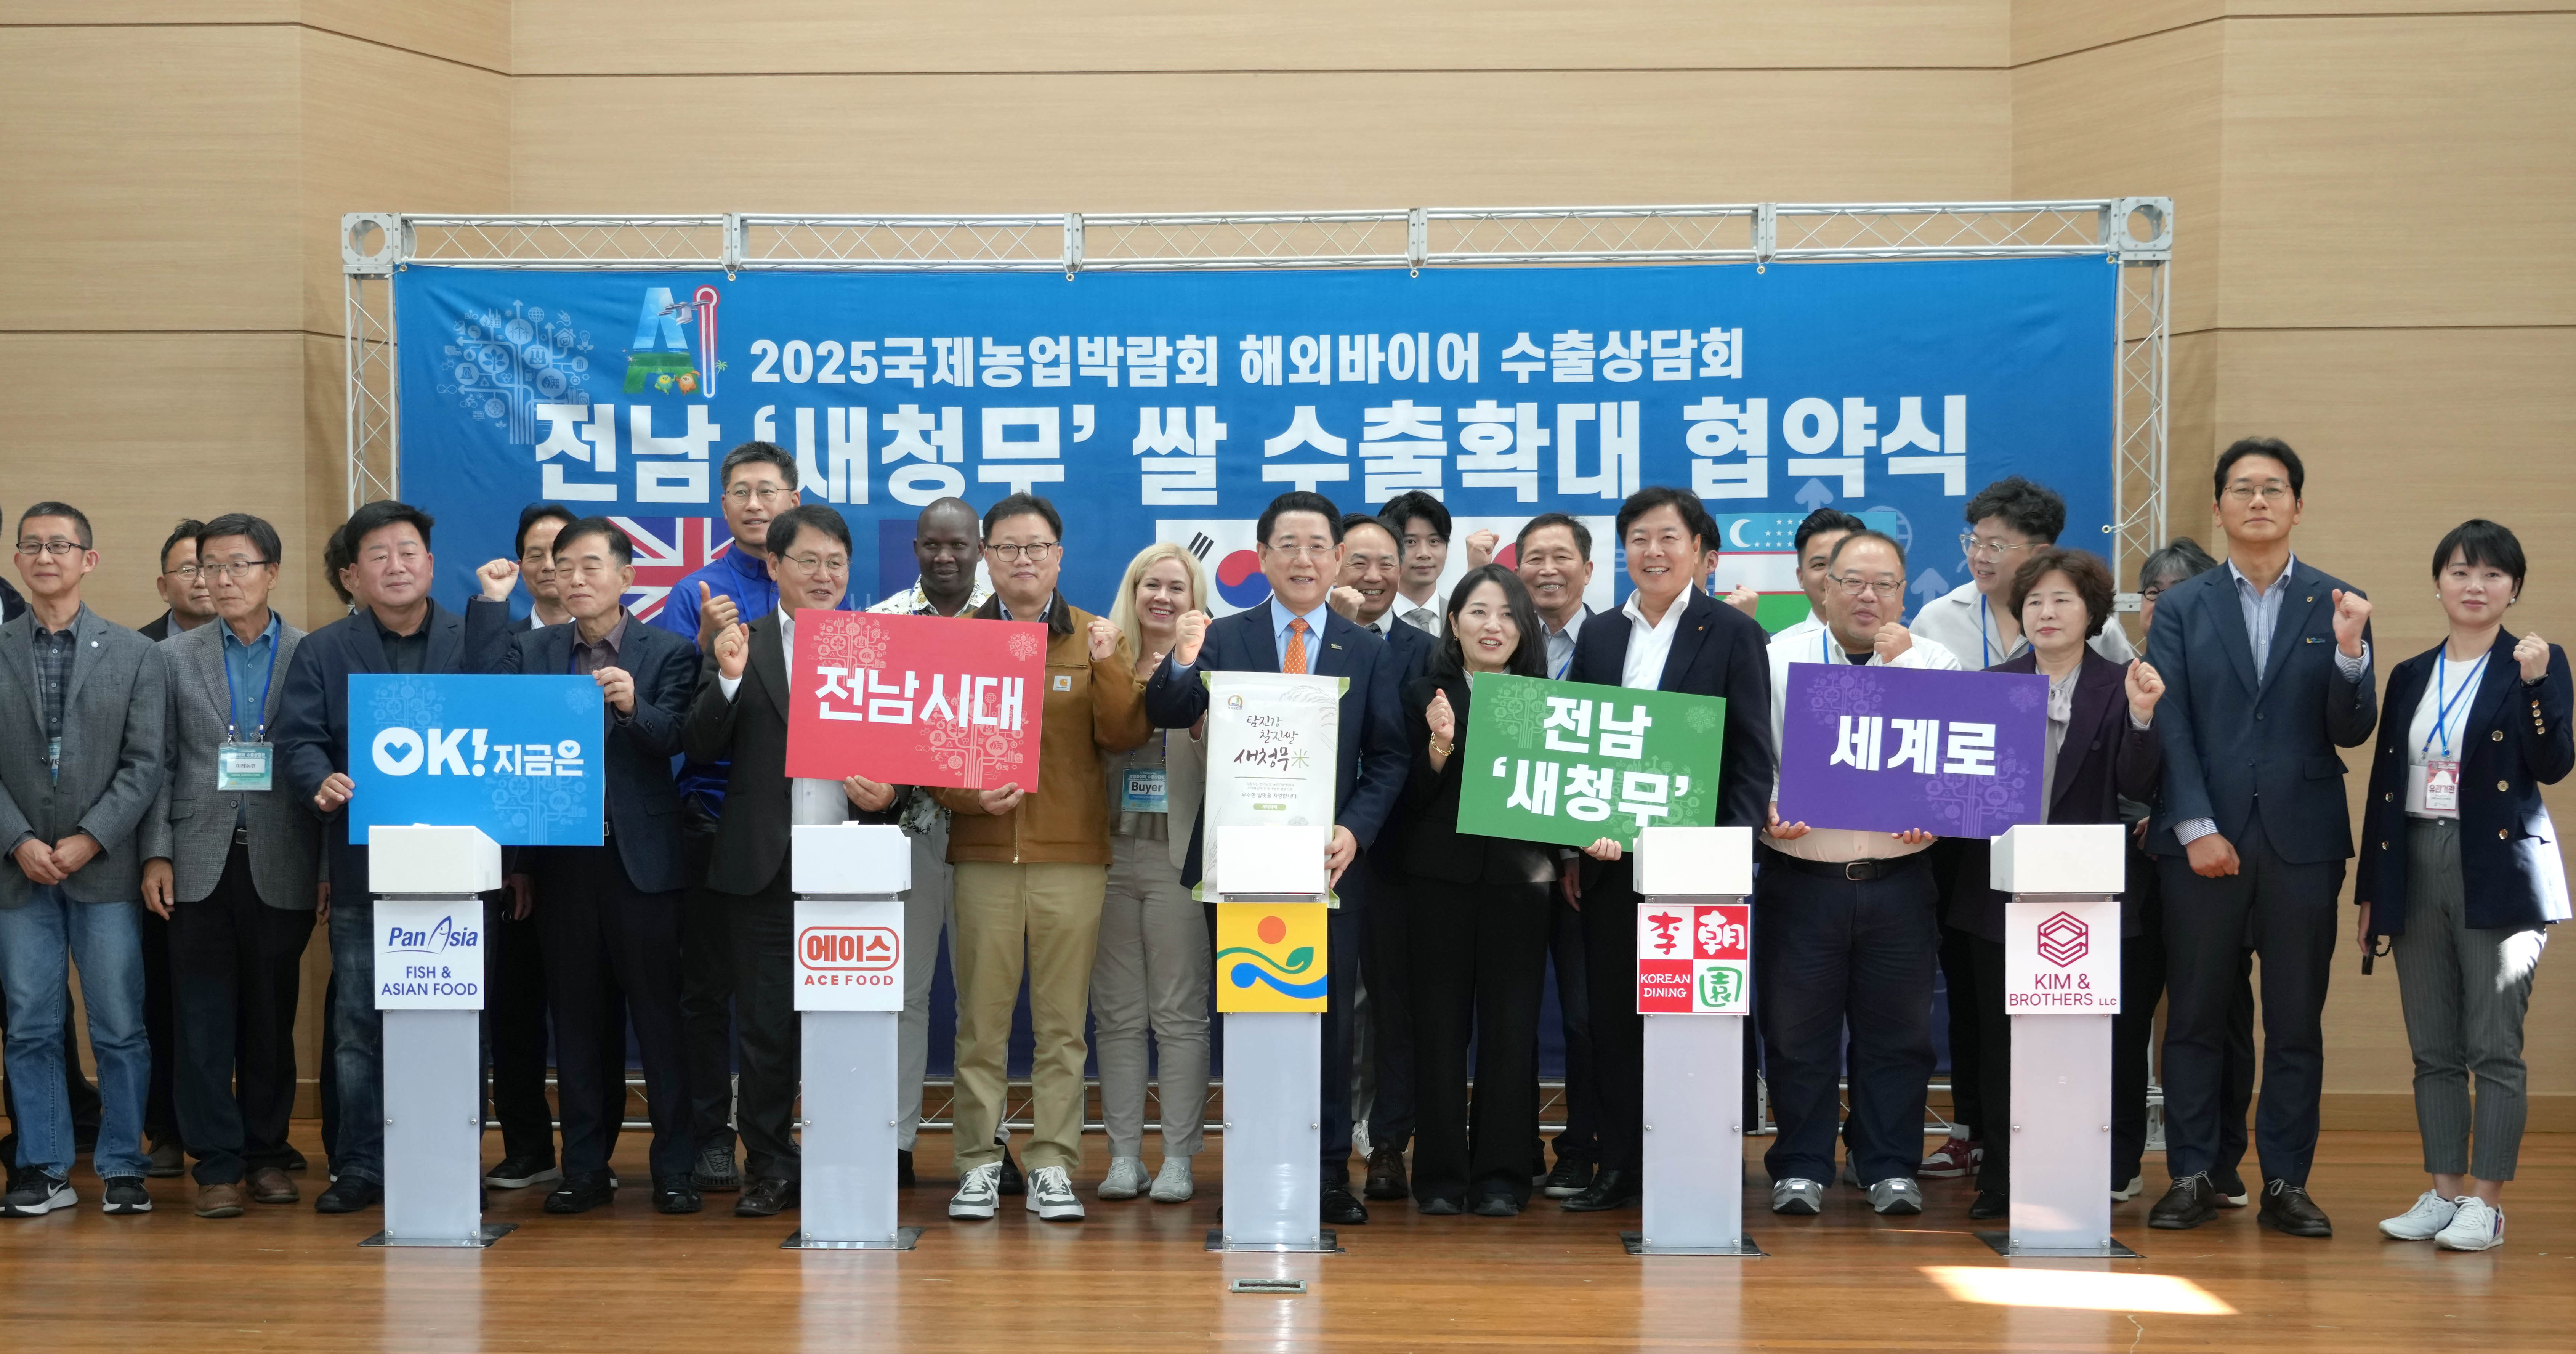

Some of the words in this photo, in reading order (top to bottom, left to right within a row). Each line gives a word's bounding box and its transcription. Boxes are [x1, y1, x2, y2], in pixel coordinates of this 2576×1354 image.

[751, 335, 1217, 387] 2025국제농업박람회
[1239, 333, 1478, 385] 해외바이어
[1501, 328, 1742, 383] 수출상담회
[536, 404, 720, 503] 전남
[1133, 406, 1227, 505] 쌀
[1262, 400, 1639, 503] 수출확대
[1683, 395, 1966, 499] 협약식
[815, 666, 1024, 731] 전남시대
[1247, 715, 1282, 727] 탐진강
[1543, 696, 1652, 759] 전남
[1259, 729, 1299, 744] 찰진쌀
[372, 727, 489, 777] OK!
[493, 740, 584, 776] 지금은
[1830, 716, 1996, 776] 세계로
[1132, 782, 1163, 794] Buyer
[2429, 785, 2455, 793] 유관기관
[389, 927, 426, 947] Pan
[427, 915, 478, 954] Asia
[807, 935, 891, 962] 에이스
[406, 966, 436, 979] FISH
[441, 966, 451, 979] &
[1640, 974, 1690, 984] KOREAN
[805, 975, 839, 985] ACE
[845, 975, 893, 986] FOOD
[2035, 974, 2071, 990] KIM
[2078, 973, 2090, 989] &
[381, 983, 428, 996] ASIAN
[434, 983, 477, 996] FOOD
[1643, 988, 1687, 998] DINING
[2010, 993, 2093, 1006] BROTHERS
